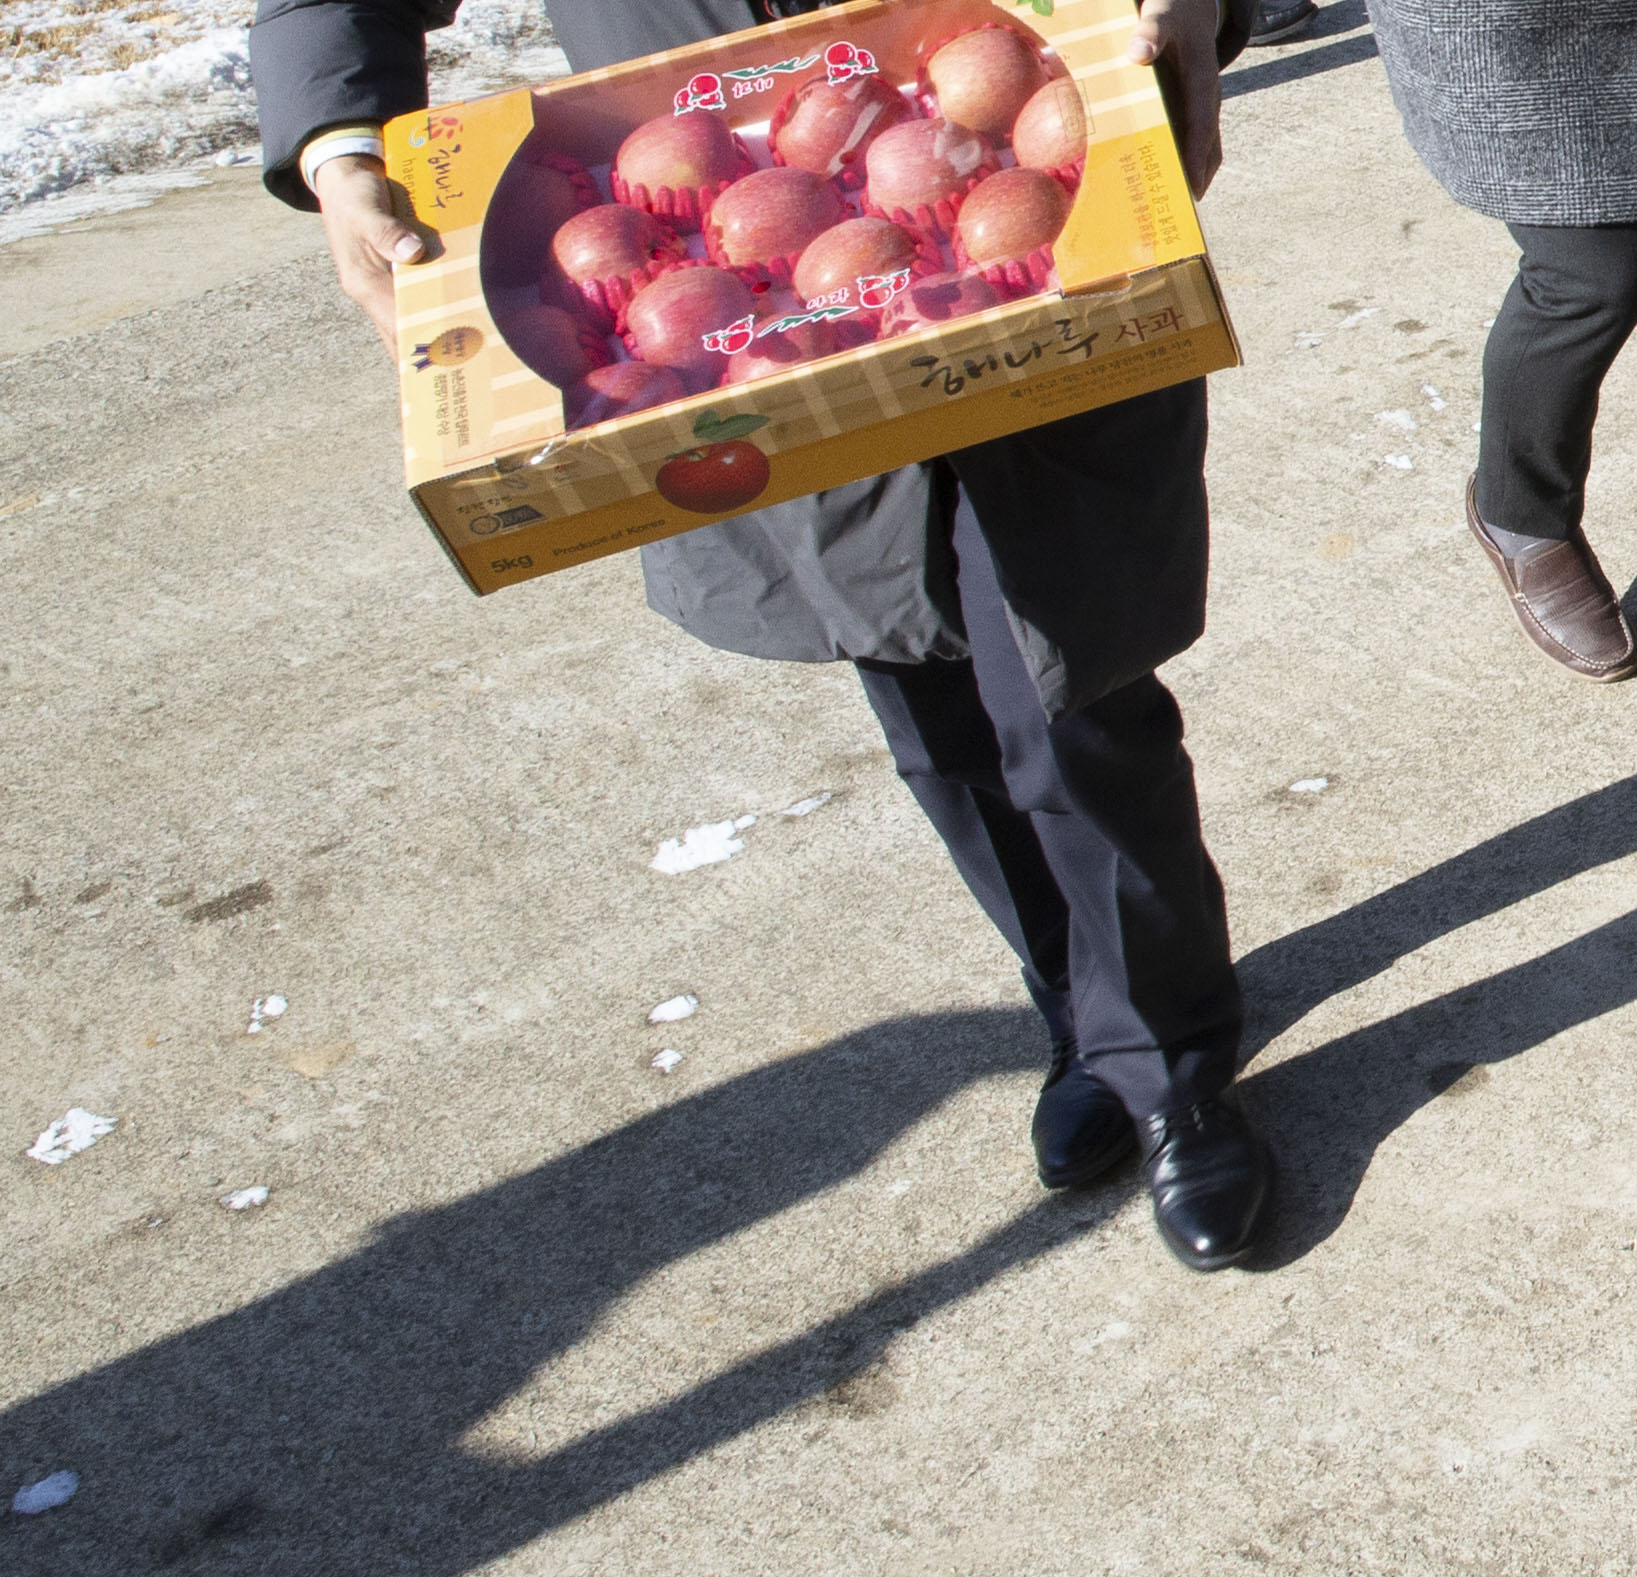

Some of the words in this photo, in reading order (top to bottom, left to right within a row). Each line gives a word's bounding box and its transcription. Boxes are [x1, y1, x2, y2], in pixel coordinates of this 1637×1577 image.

[910, 319, 1099, 395] 해나루
[1115, 307, 1184, 343] 사과
[491, 554, 533, 574] 5kg
